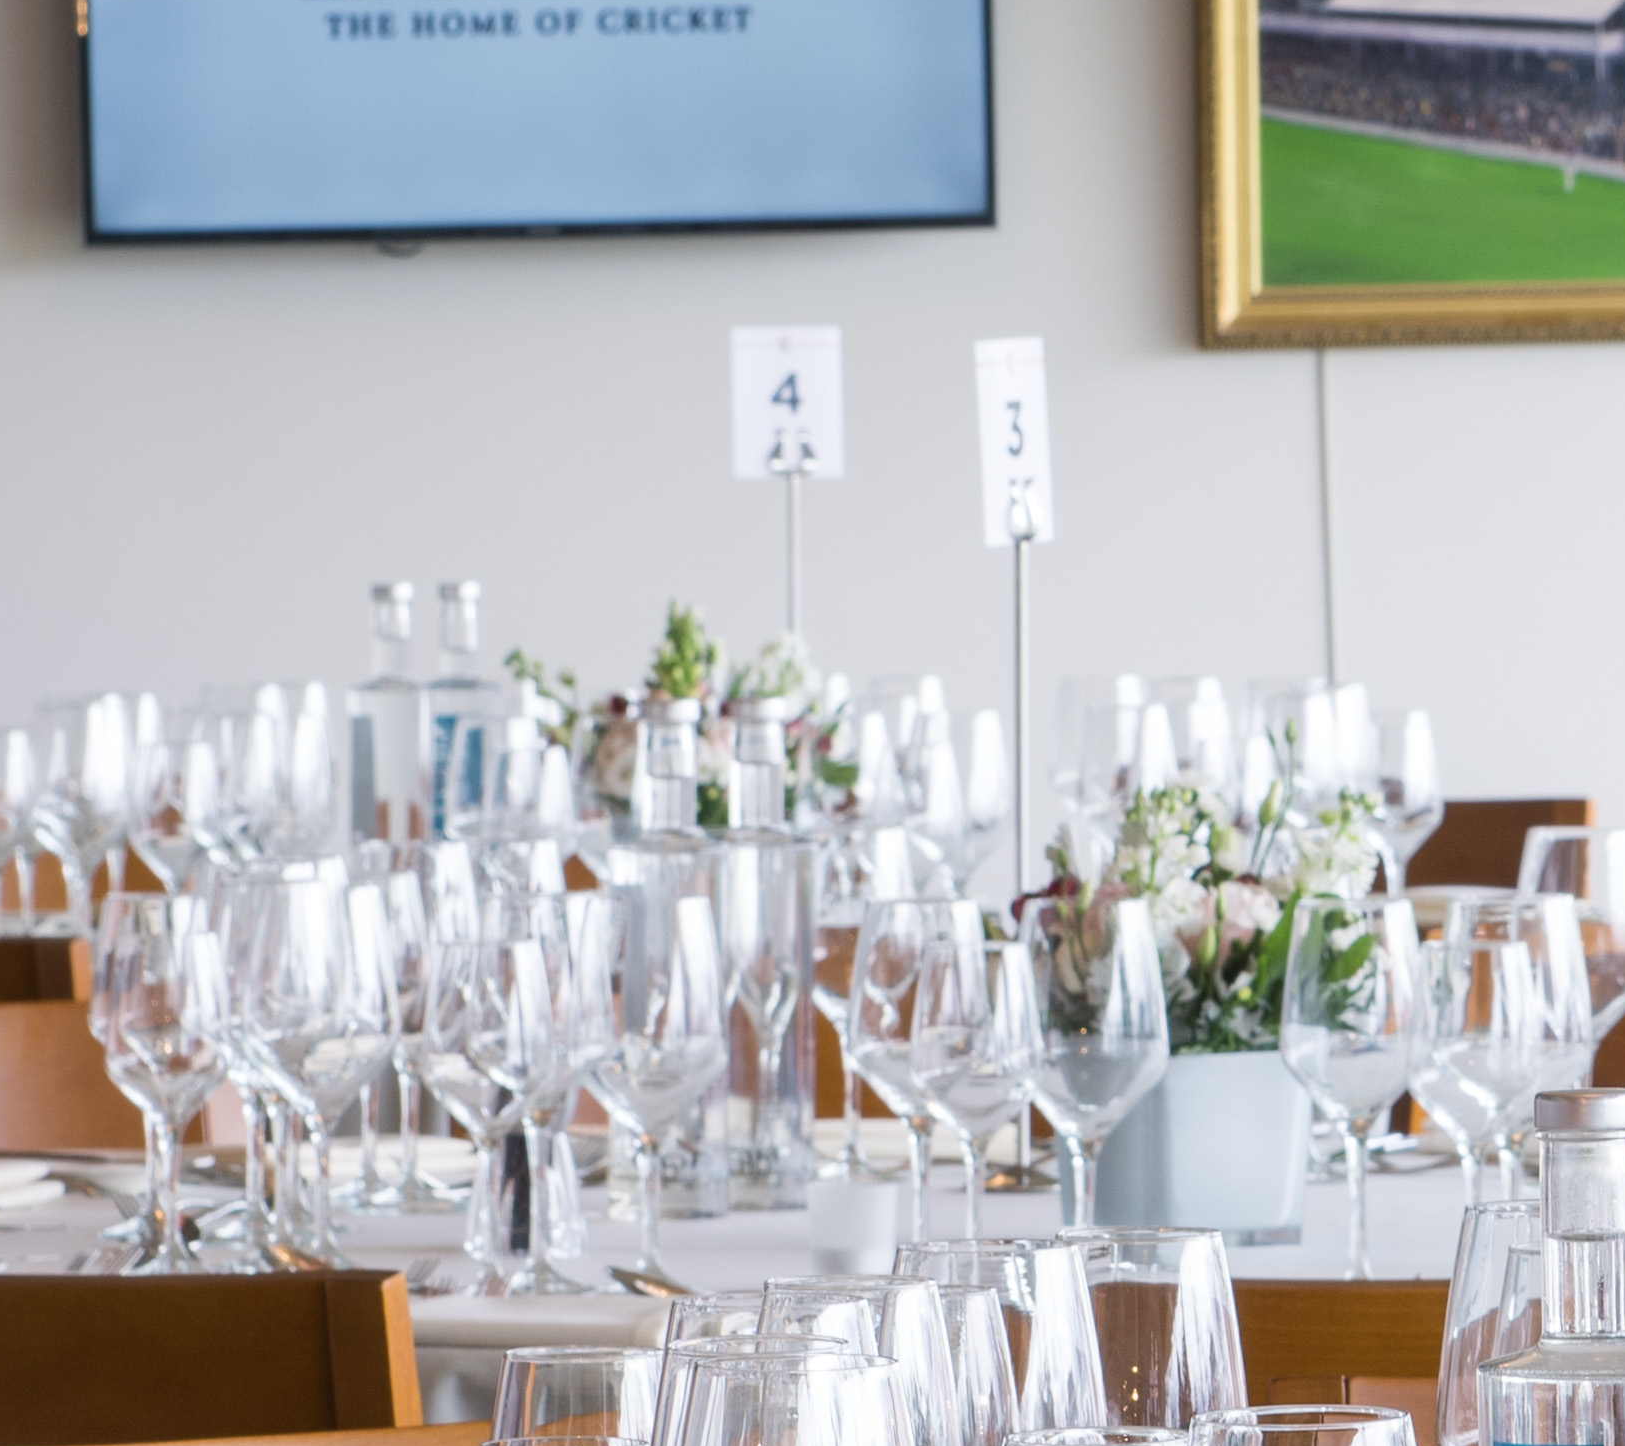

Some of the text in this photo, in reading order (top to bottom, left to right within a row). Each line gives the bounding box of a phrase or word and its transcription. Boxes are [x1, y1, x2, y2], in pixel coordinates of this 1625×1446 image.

[326, 4, 753, 39] THE HOME OF CRICKET
[770, 372, 801, 414] 4
[1005, 401, 1024, 457] 3
